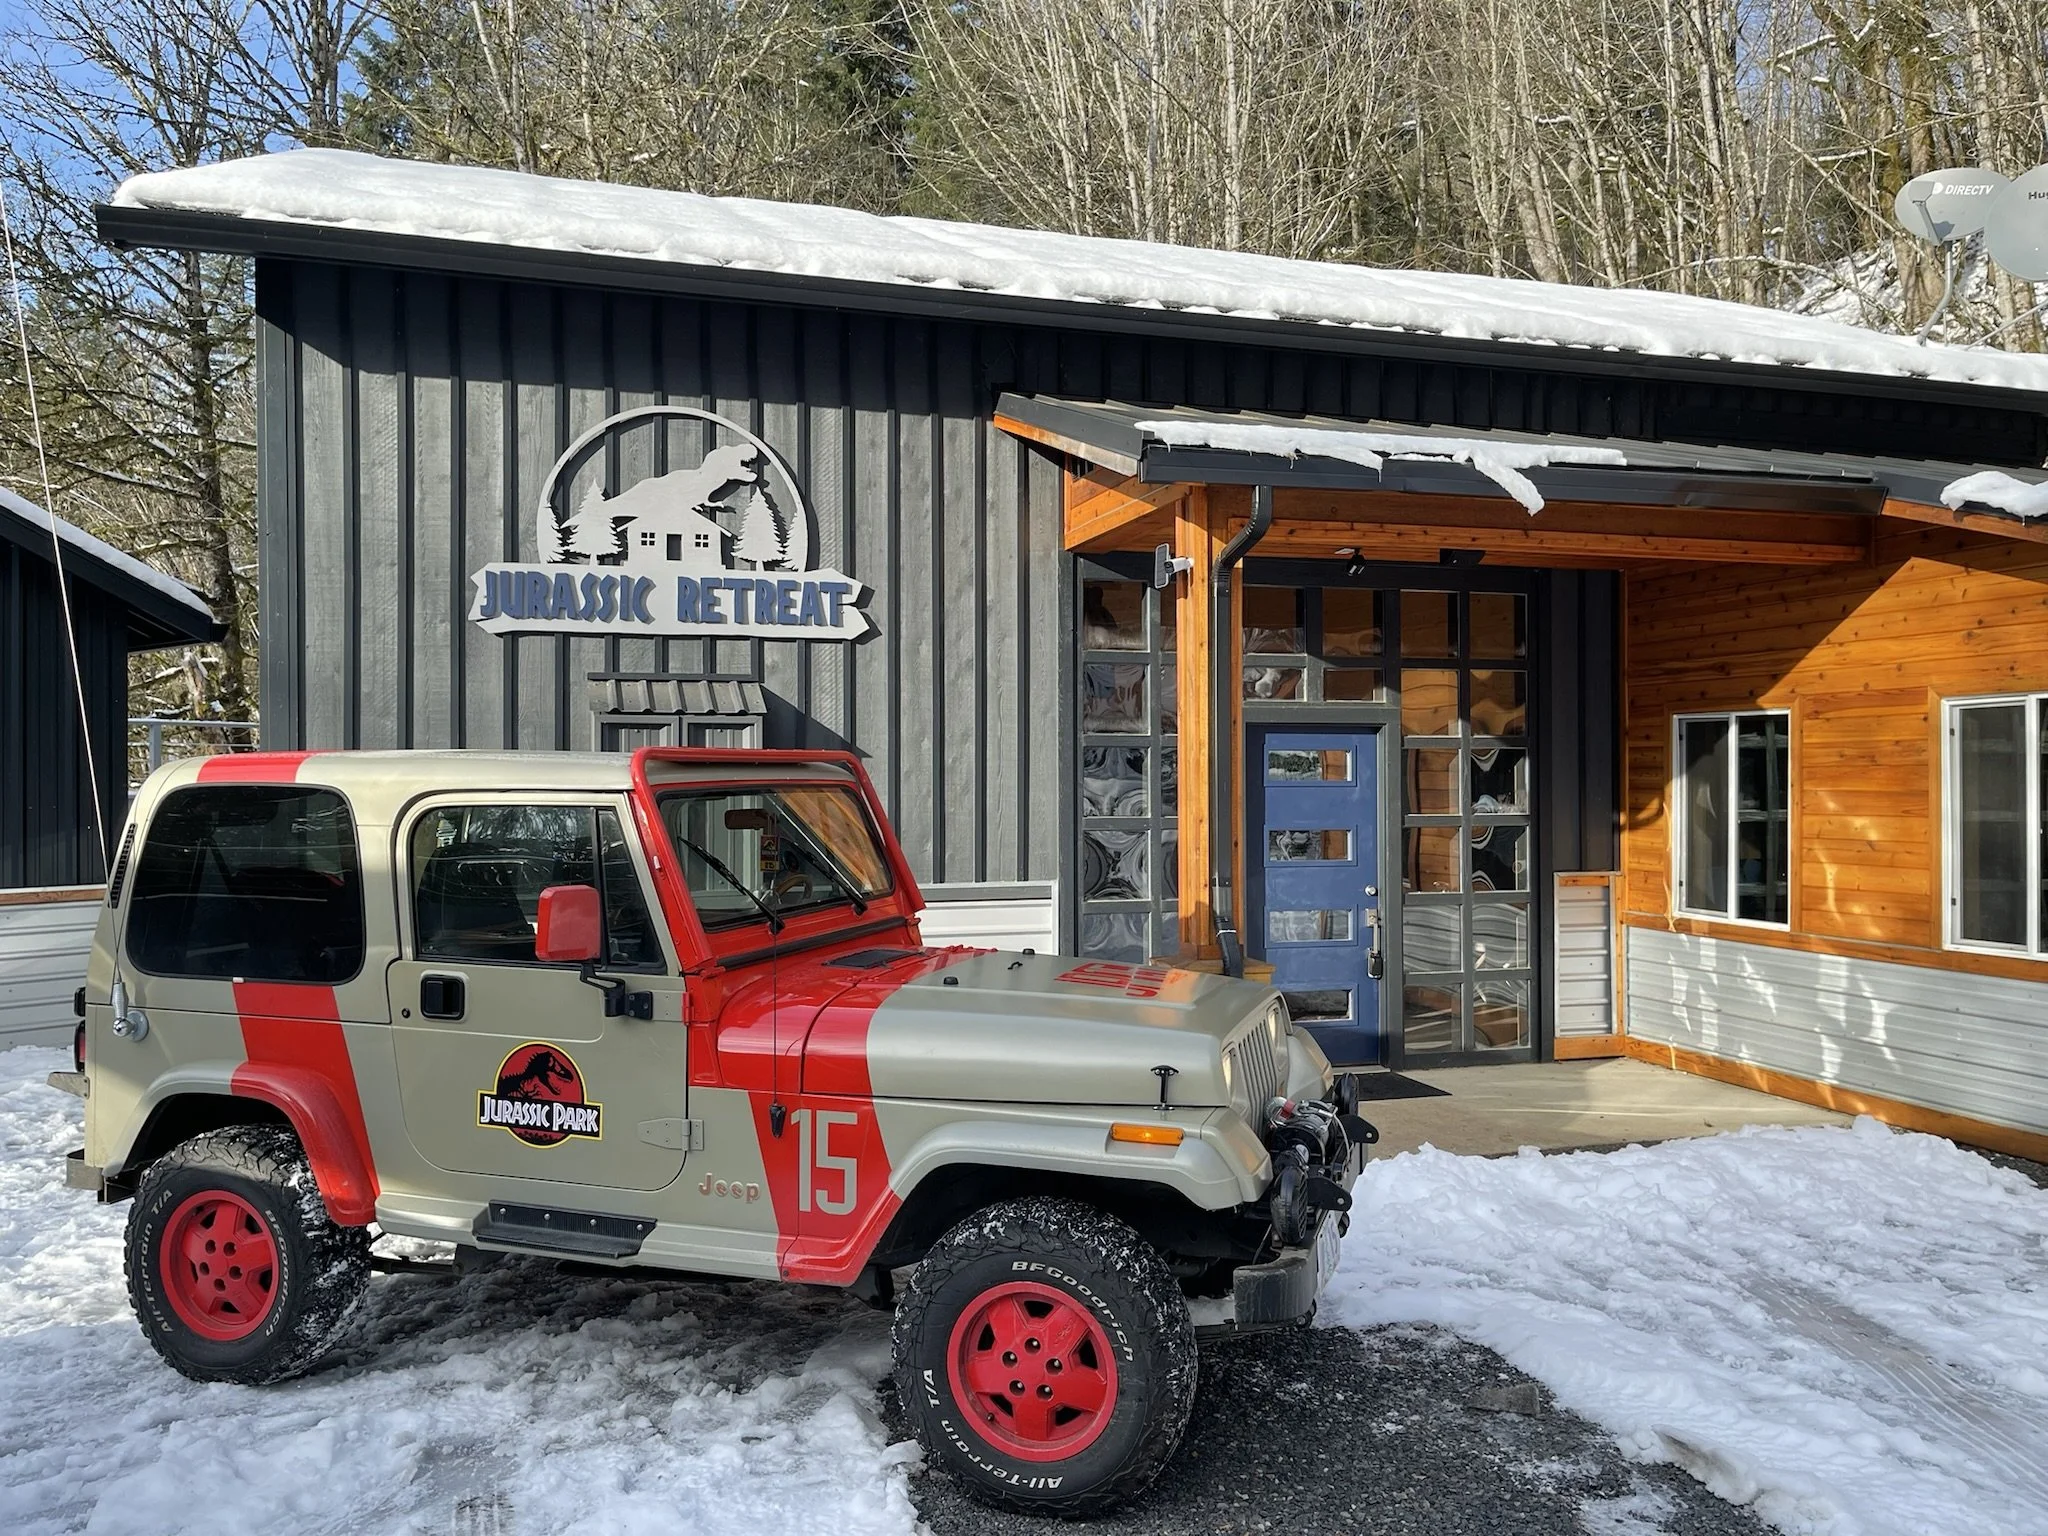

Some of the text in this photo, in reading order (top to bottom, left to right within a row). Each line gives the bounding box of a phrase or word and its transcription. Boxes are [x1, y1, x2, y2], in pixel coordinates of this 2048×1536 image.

[1945, 184, 1995, 196] DIRECTV
[480, 570, 852, 627] JURASSIC RETREAT
[480, 1096, 599, 1133] JURASSIC PARK
[791, 1108, 858, 1216] 15
[151, 1189, 173, 1215] T/A
[698, 1172, 760, 1204] Jeep
[1011, 1260, 1134, 1362] BFGoodrich
[923, 1369, 1063, 1489] All-Terrain T/A
